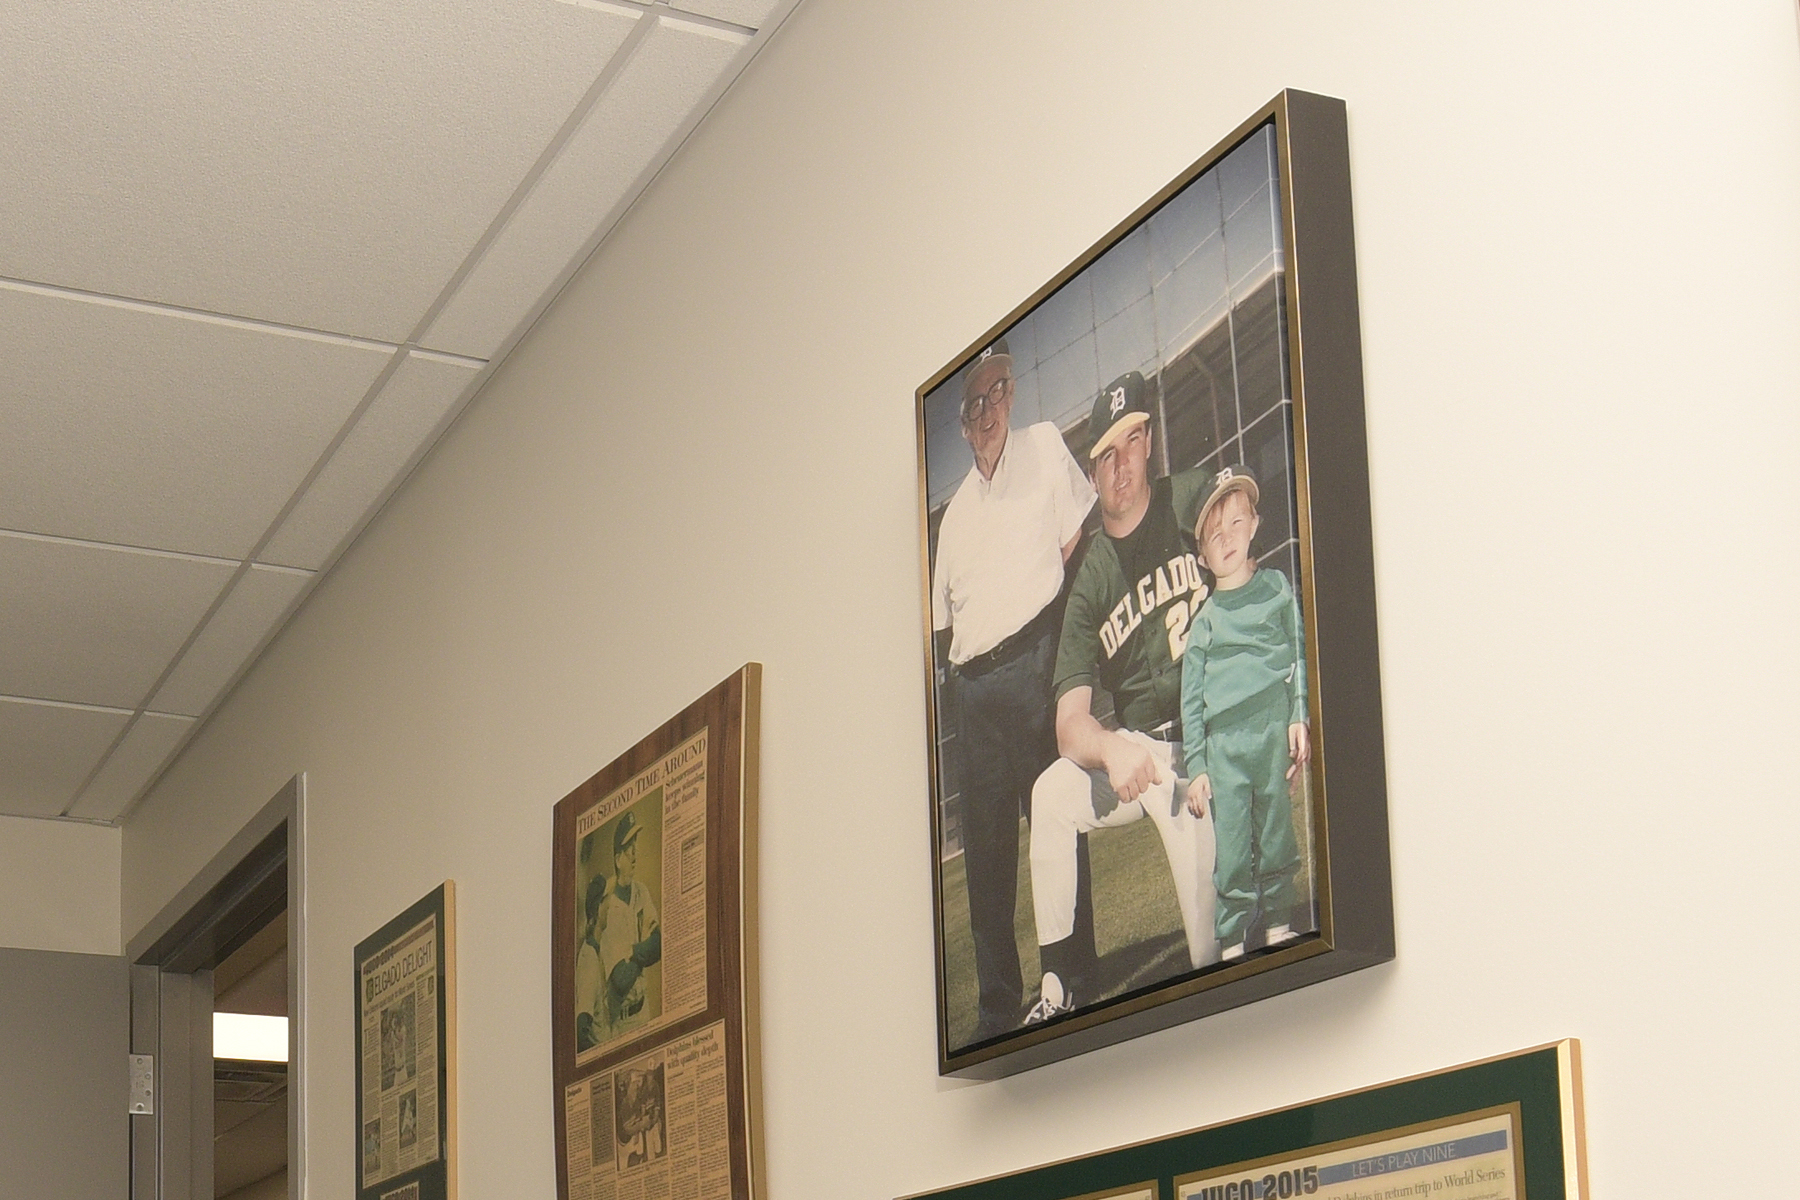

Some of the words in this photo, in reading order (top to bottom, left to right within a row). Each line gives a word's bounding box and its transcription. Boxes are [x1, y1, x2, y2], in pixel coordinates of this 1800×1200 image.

[1109, 386, 1125, 420] D
[1099, 553, 1203, 659] DELGADO
[578, 812, 596, 834] THE
[597, 787, 634, 821] SECOND
[635, 769, 660, 795] TIME
[662, 738, 706, 778] AROUND
[402, 940, 433, 979] DELIGHT
[1352, 1158, 1385, 1177] LET'S
[1388, 1150, 1419, 1170] PLAY
[1422, 1143, 1456, 1161] NINE
[1374, 1189, 1383, 1200] in
[1384, 1183, 1414, 1199] return
[1415, 1181, 1431, 1198] trip
[1433, 1179, 1443, 1191] to
[1444, 1170, 1474, 1188] World
[1476, 1167, 1506, 1183] Series
